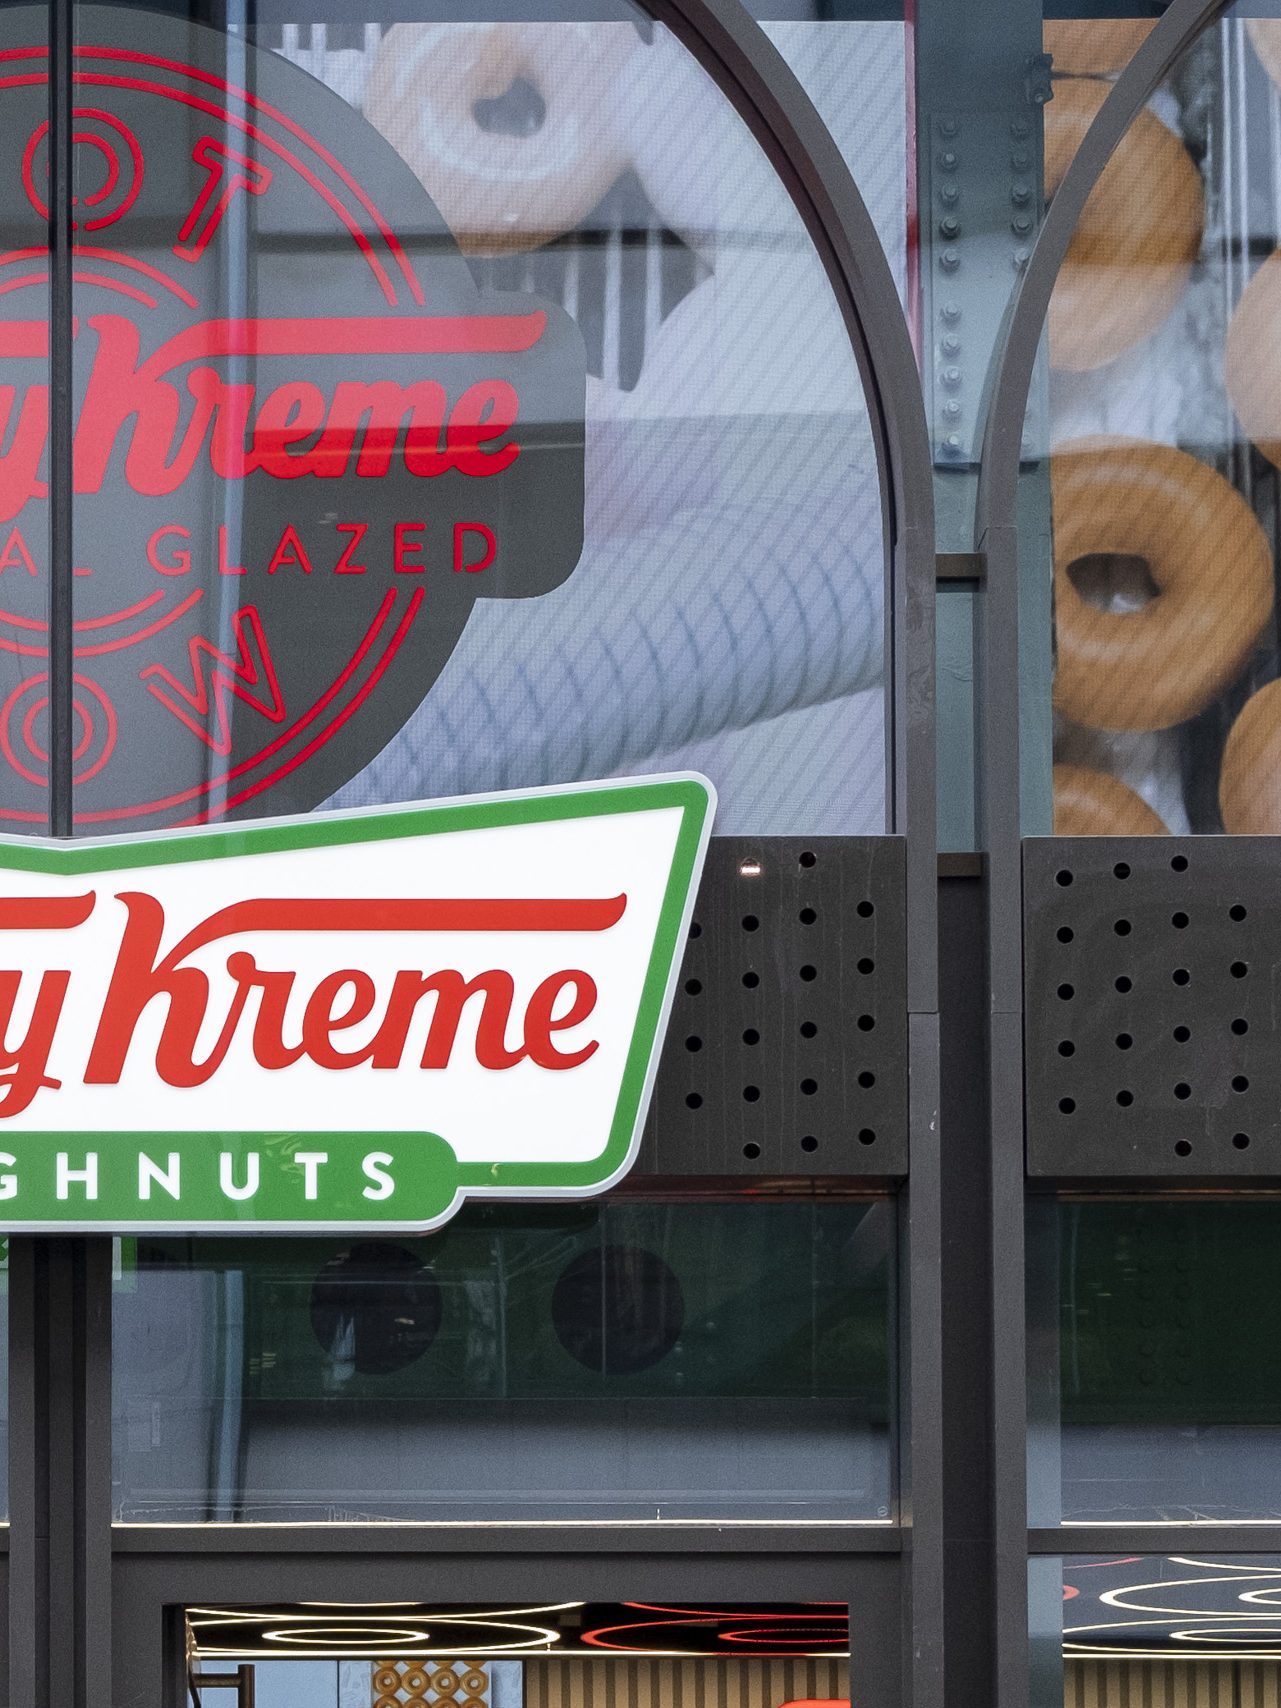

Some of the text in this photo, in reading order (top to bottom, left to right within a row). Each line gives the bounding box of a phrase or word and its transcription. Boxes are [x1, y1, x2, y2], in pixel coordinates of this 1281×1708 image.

[72, 311, 549, 499] Kreme
[146, 521, 498, 577] GLAZED
[83, 889, 628, 1089] Kreme
